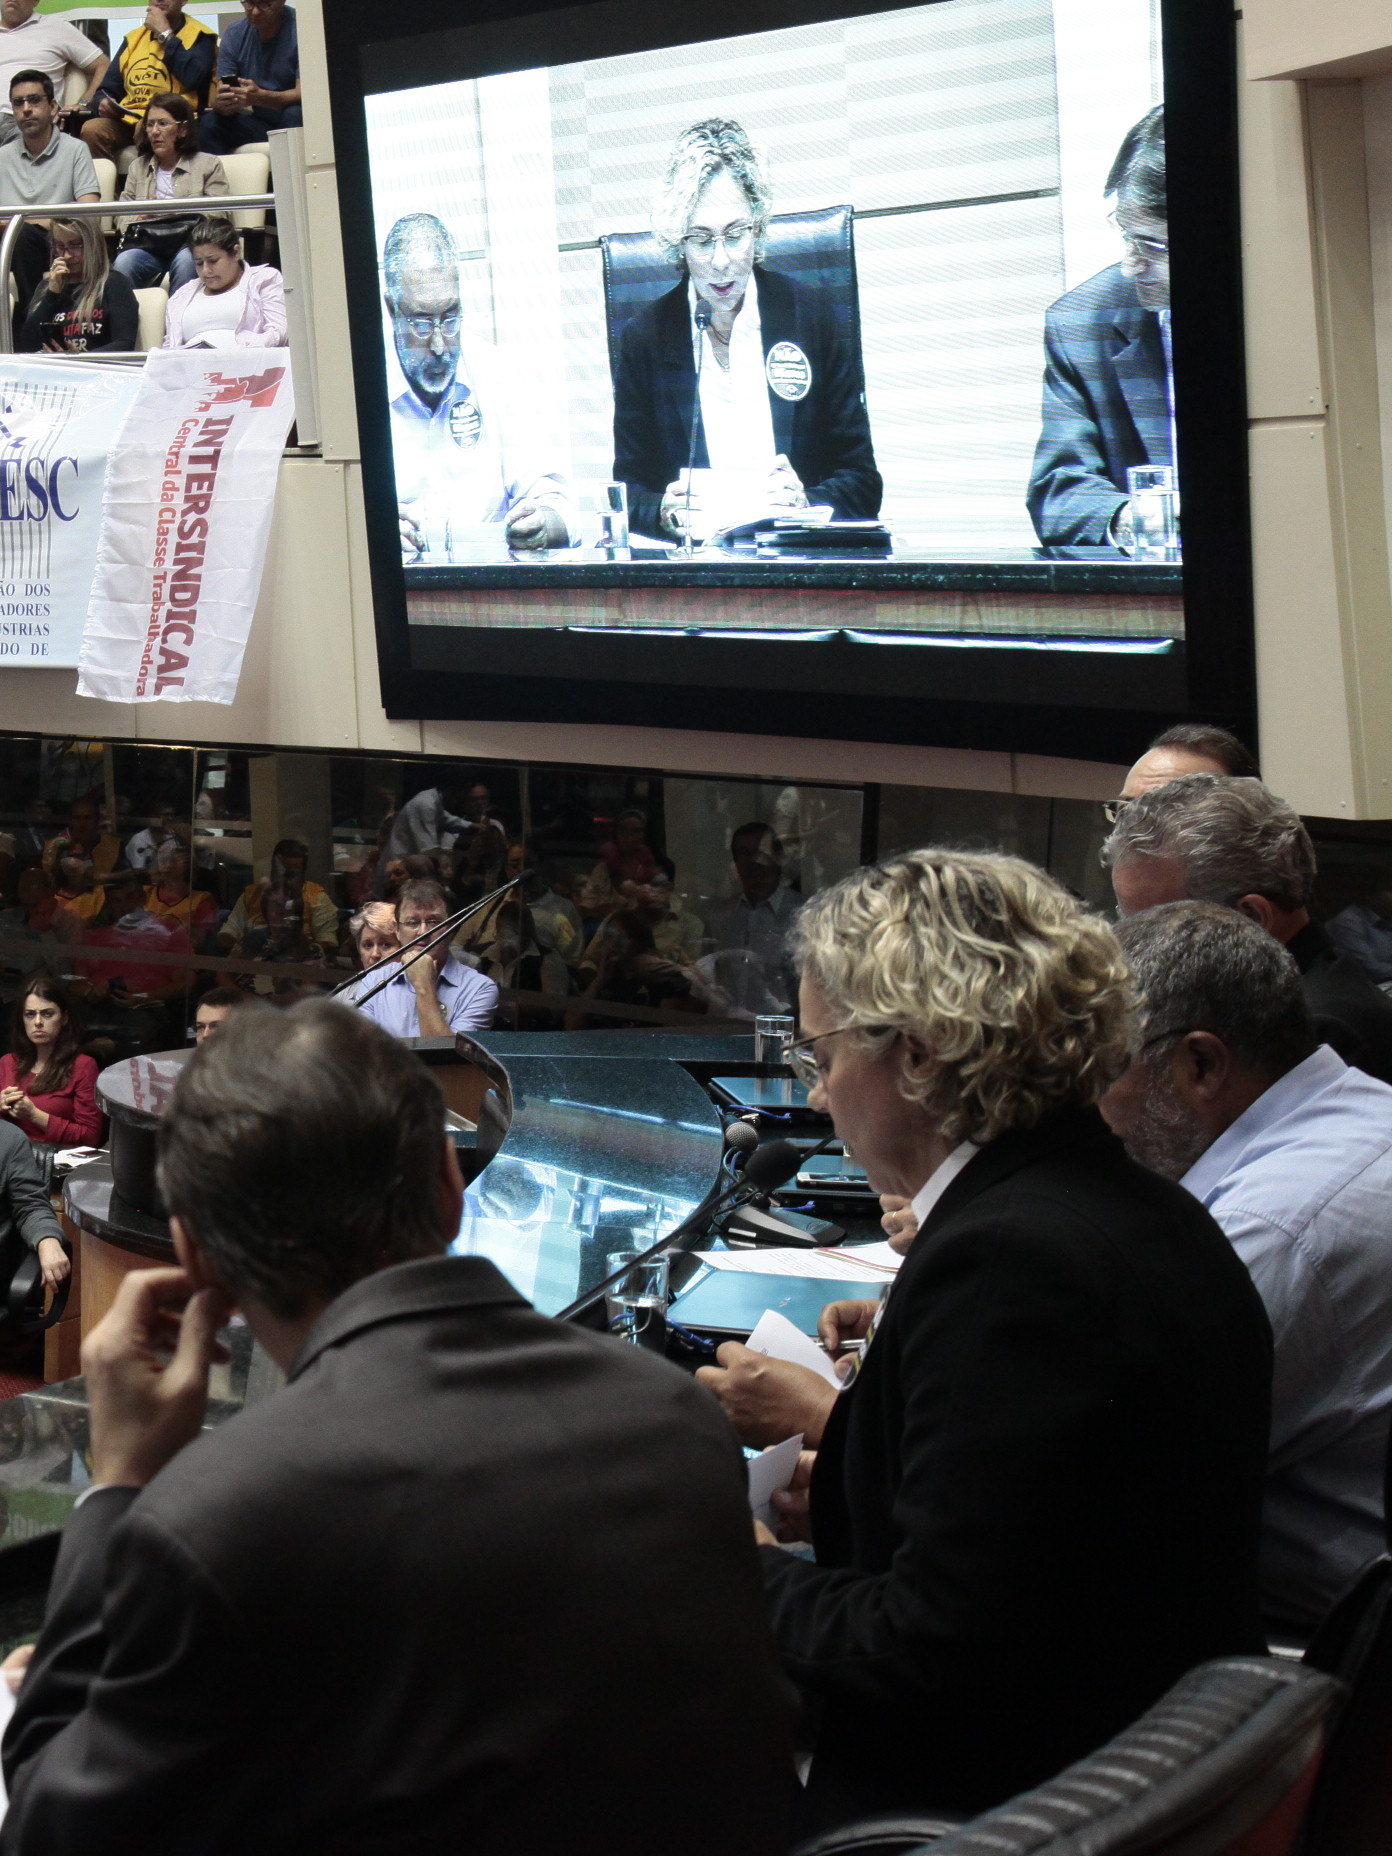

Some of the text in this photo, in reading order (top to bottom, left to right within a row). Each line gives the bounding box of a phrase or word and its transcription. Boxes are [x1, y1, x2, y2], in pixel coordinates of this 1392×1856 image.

[134, 88, 151, 96] OVA
[63, 323, 81, 336] UTA
[136, 418, 200, 697] Central da Classe Trabalhadora
[153, 414, 235, 696] INTERSINDICAL
[24, 583, 51, 597] DOS
[30, 642, 50, 656] DE
